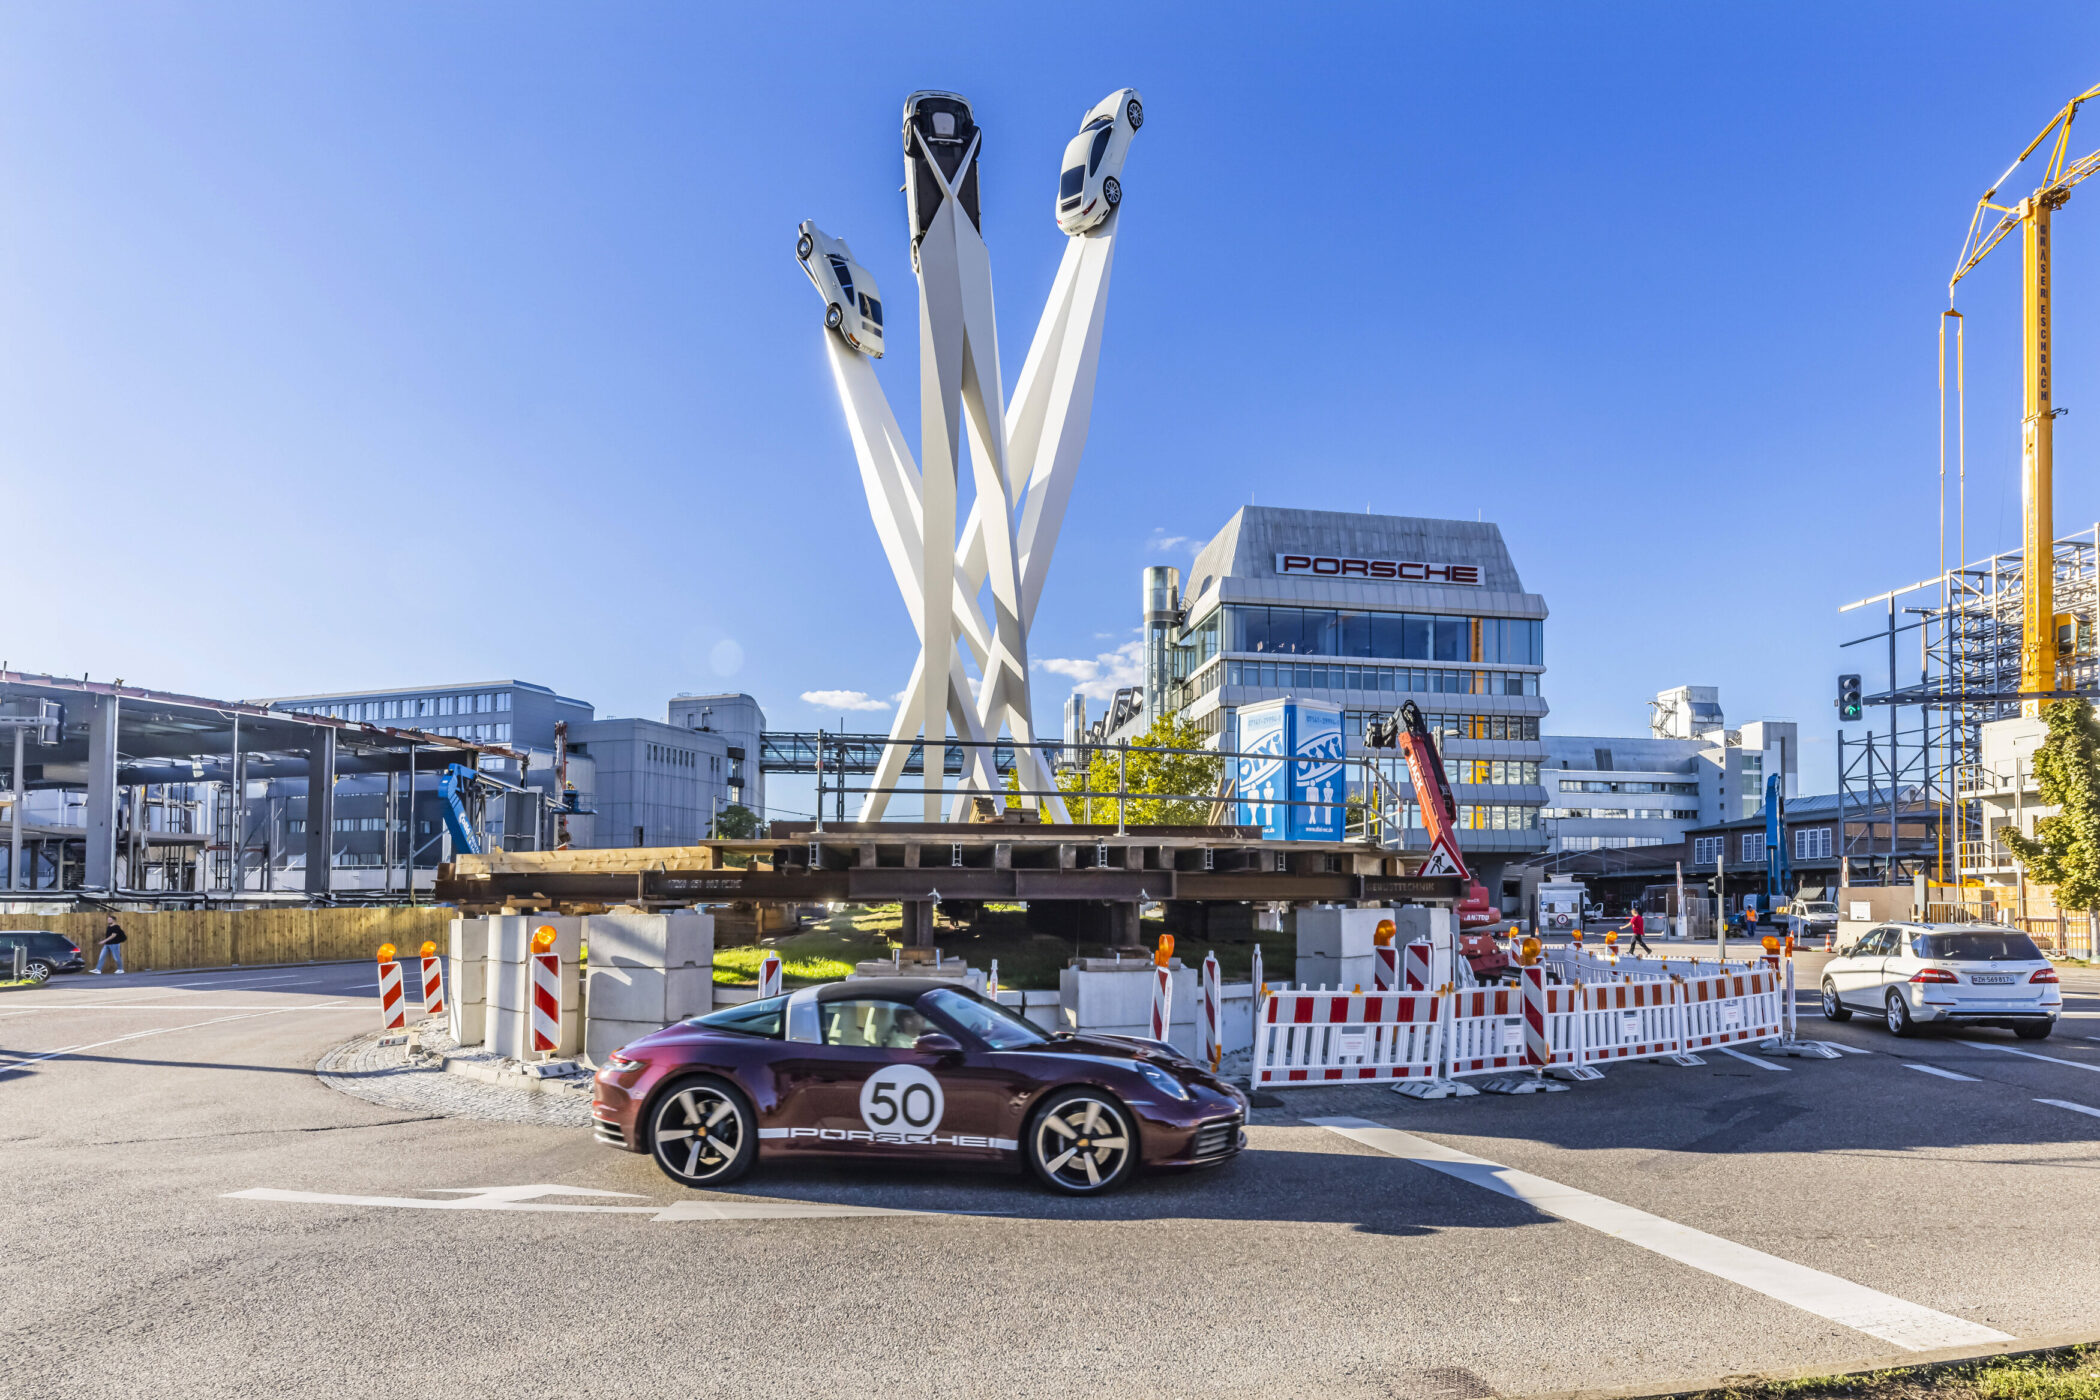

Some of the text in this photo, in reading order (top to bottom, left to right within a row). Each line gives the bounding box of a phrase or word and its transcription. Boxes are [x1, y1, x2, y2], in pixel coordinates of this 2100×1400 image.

[2040, 304, 2048, 401] ESCHBACH
[1284, 555, 1478, 583] PORSCHE
[1408, 754, 1423, 791] MACK
[868, 1082, 935, 1127] 50
[790, 1127, 989, 1148] PORSCHE
